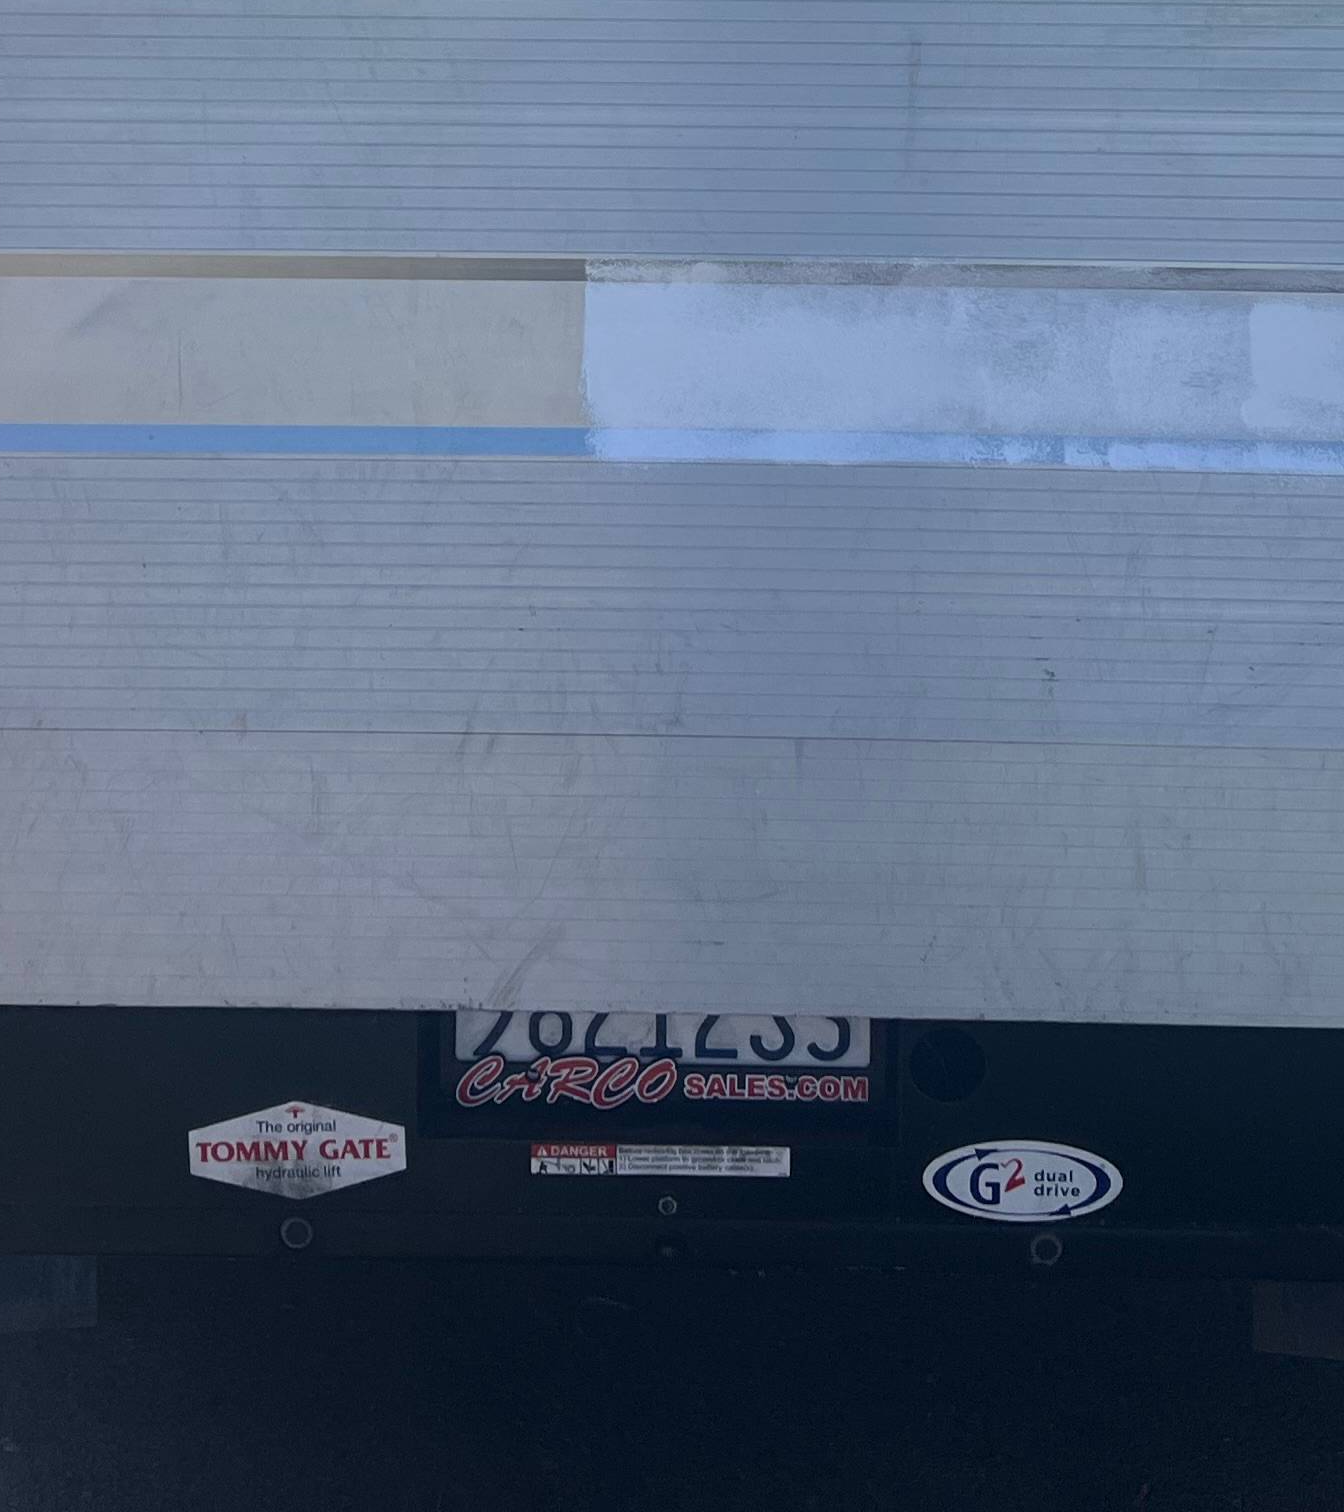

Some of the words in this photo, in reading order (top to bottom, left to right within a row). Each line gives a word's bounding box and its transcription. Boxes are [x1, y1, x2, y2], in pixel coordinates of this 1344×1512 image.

[456, 1054, 677, 1110] CARCO
[683, 1073, 869, 1103] SALES.COM
[257, 1120, 283, 1133] The
[287, 1119, 336, 1136] original
[196, 1140, 307, 1163] TOMMY
[550, 1146, 608, 1157] DANGER
[256, 1165, 320, 1180] hydraulic
[323, 1165, 341, 1178] lift
[1034, 1169, 1073, 1183] dual
[1034, 1184, 1080, 1197] drive
